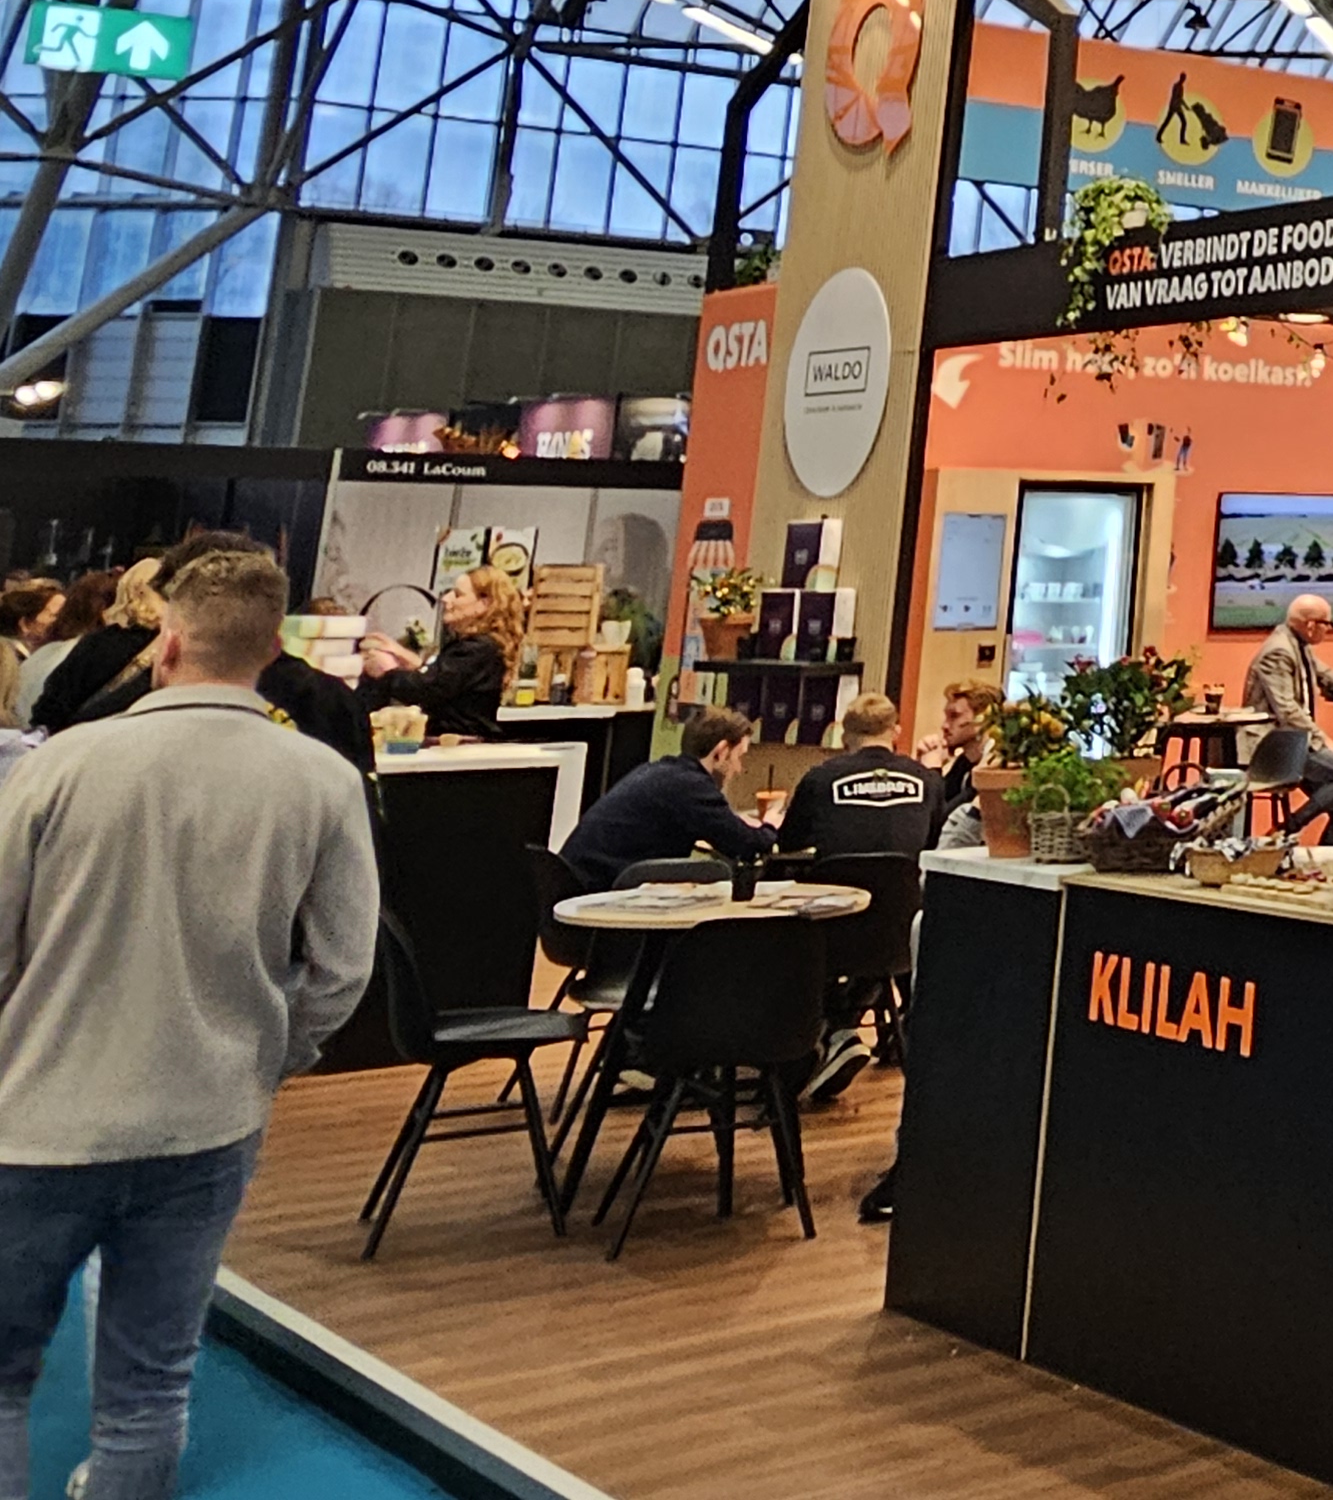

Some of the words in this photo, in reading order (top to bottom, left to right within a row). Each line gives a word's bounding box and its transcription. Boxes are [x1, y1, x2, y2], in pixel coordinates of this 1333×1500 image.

[1069, 158, 1114, 177] ERSER
[1157, 169, 1214, 191] SNELLER
[1160, 230, 1251, 270] VERBINDT
[1252, 227, 1279, 258] DE
[1105, 280, 1142, 311] VAN
[1144, 271, 1209, 307] VRAAG
[1211, 266, 1248, 299] TOT
[706, 319, 768, 374] QSTA
[998, 341, 1060, 371] Slim
[812, 360, 862, 383] WALDO
[1088, 951, 1256, 1059] KLILAH
